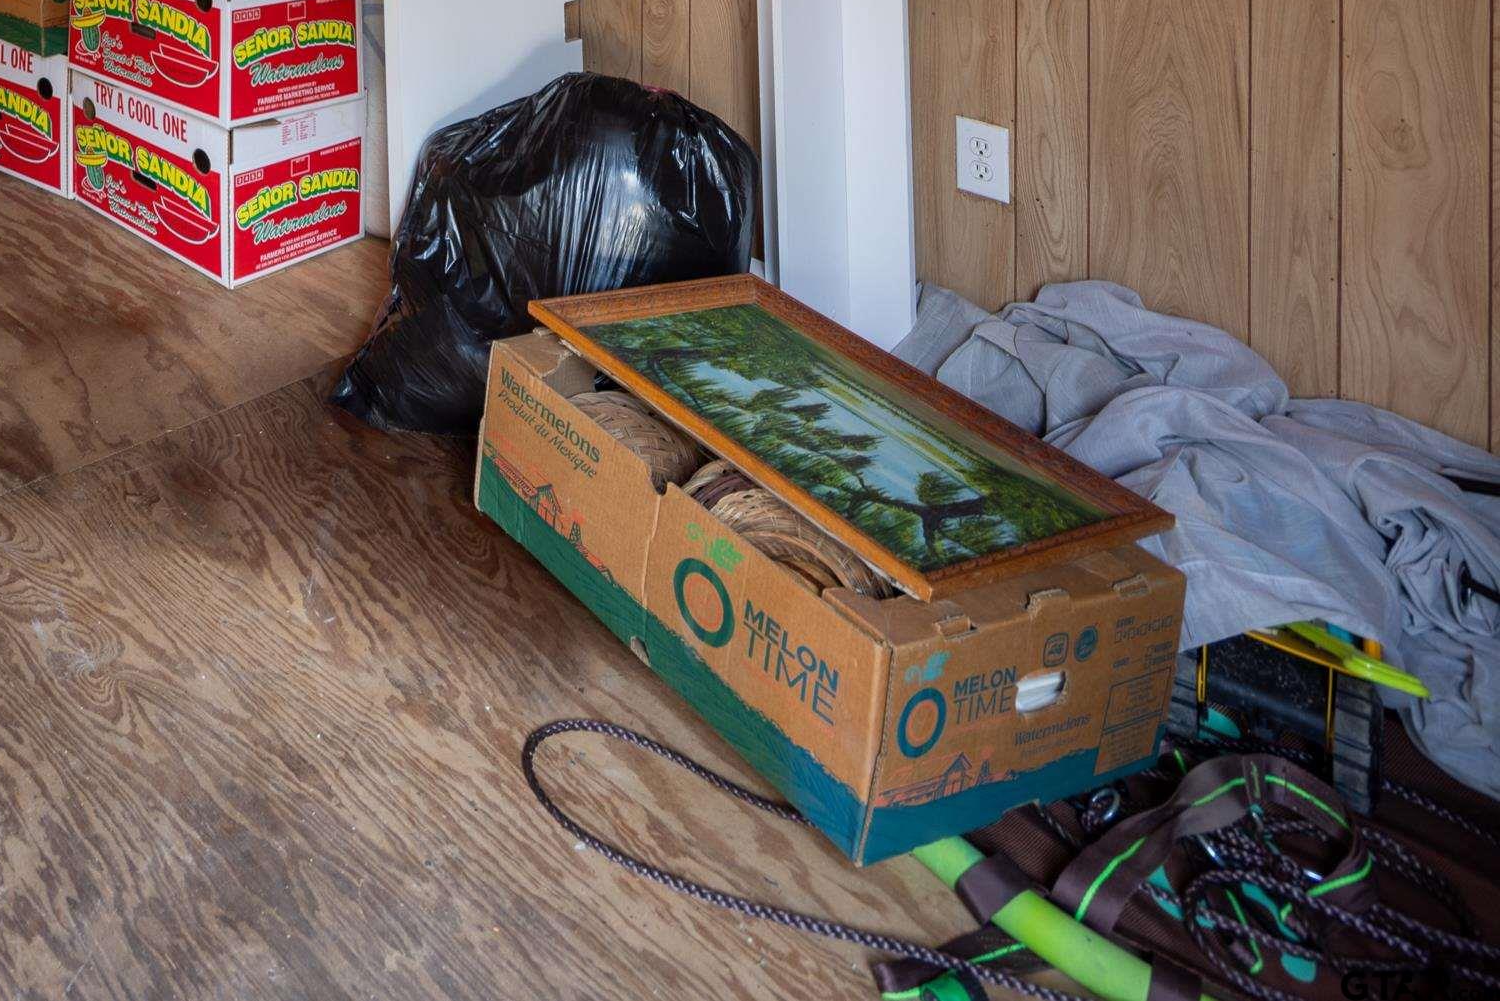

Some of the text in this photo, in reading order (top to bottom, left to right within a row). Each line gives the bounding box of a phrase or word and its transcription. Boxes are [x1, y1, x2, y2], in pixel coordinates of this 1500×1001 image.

[11, 48, 34, 73] ONE
[233, 19, 355, 69] SEÑOR SANDIA
[250, 52, 344, 87] Watermelons
[94, 82, 188, 143] TRY A COOL ONE
[257, 93, 283, 106] FARMERS
[283, 87, 314, 101] MARKETING
[314, 82, 335, 94] SERVICE
[75, 123, 212, 221] SEÑOR SANDIA
[236, 168, 359, 231] SEÑOR SANDIA
[252, 200, 347, 245] Watermelons
[260, 246, 286, 262] FARMERS
[285, 236, 316, 254] MARKETING
[316, 228, 338, 245] SERVICE
[498, 389, 597, 478] Produit du Mexique
[501, 366, 600, 463] Watermelons
[743, 599, 840, 693] MELON
[743, 621, 836, 727] TIME
[953, 666, 1018, 698] MELON
[953, 686, 1016, 724] TIME
[1014, 714, 1091, 746] Watermelons
